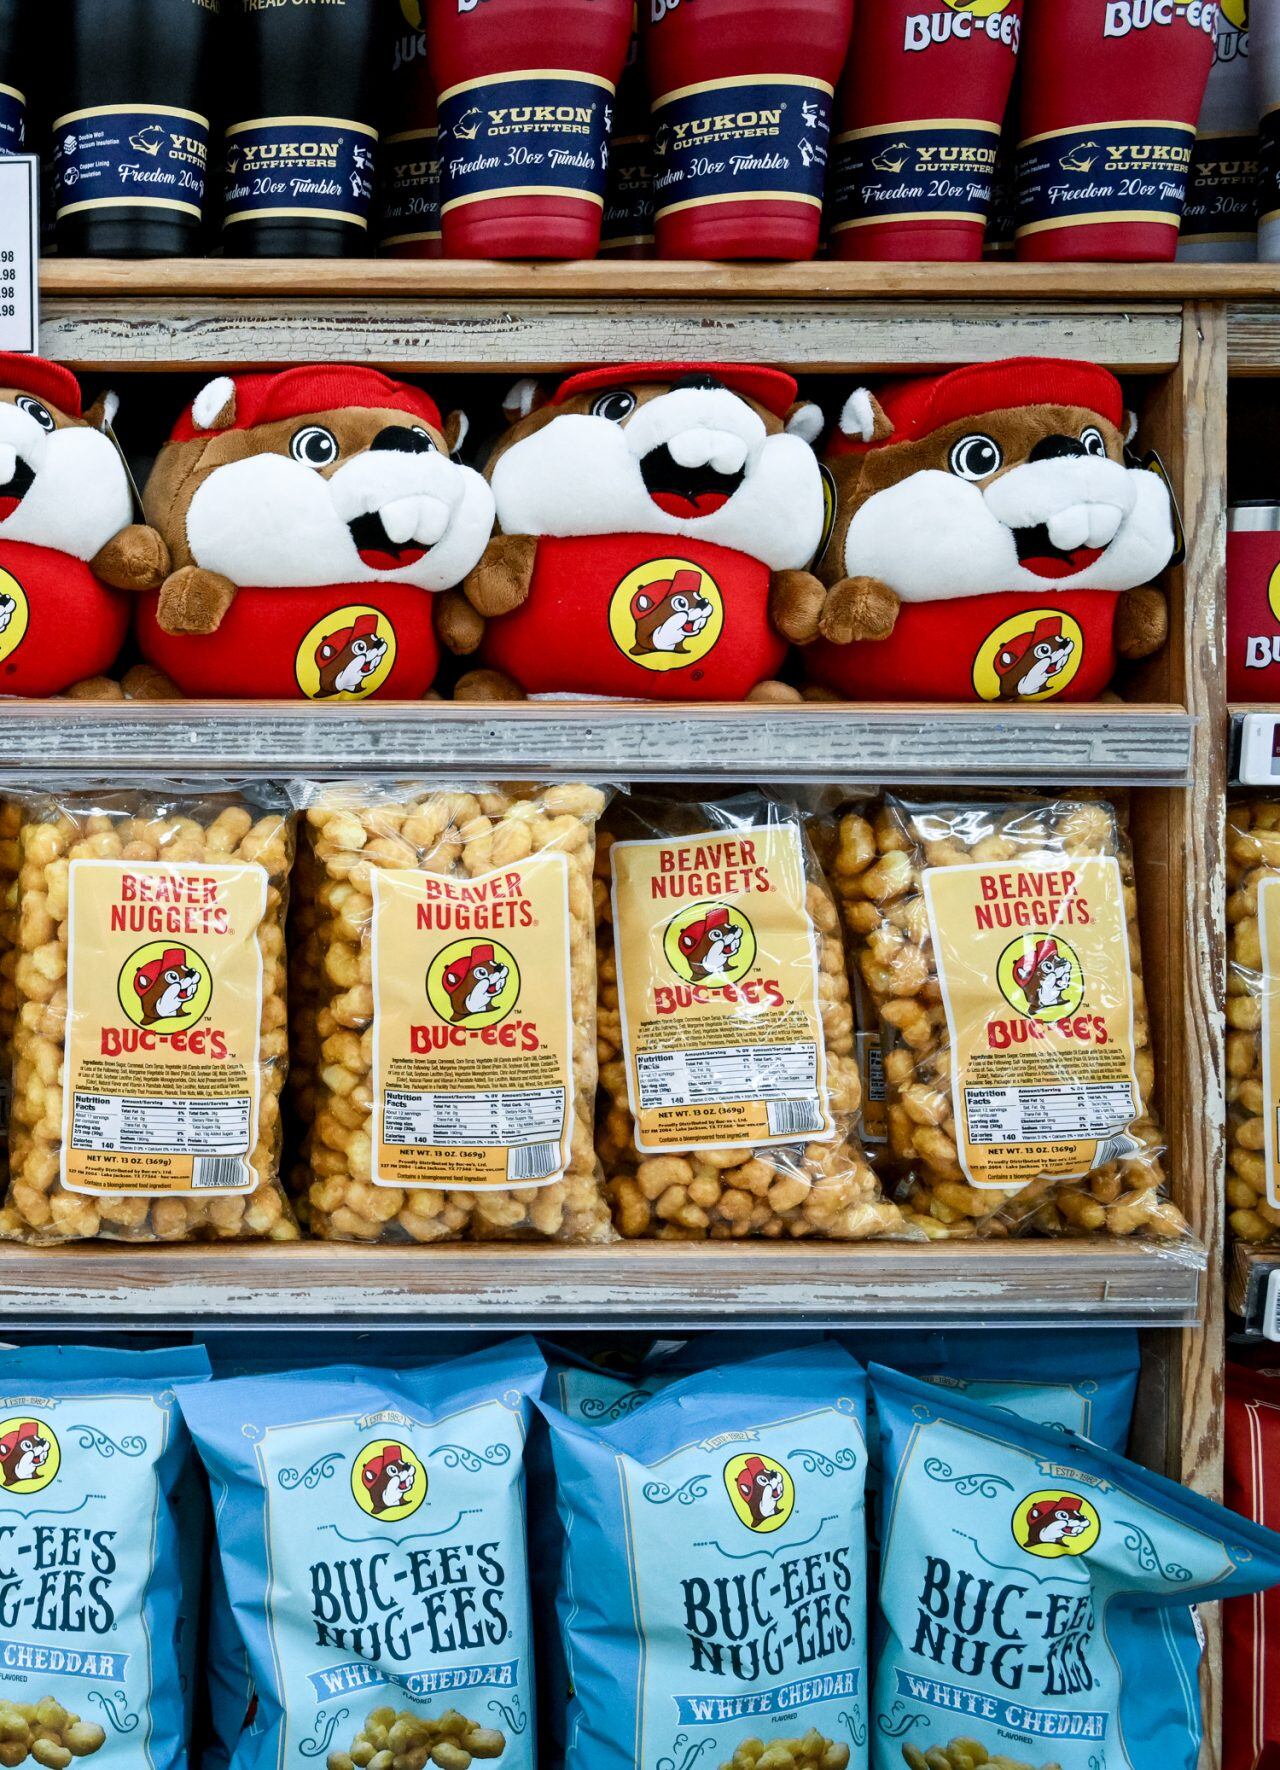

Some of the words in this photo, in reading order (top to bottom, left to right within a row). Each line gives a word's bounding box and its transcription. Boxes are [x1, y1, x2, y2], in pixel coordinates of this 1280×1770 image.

[488, 106, 593, 124] YUKON
[488, 123, 590, 136] OUTFITTERS
[673, 109, 782, 138] YUKON
[243, 143, 339, 160] YUKON
[674, 127, 779, 150] OUTFITTERS
[1106, 146, 1192, 162] YUKON
[243, 159, 336, 171] OUTFITTERS
[450, 156, 500, 179] Freedom
[504, 146, 544, 166] 30oz
[548, 149, 595, 169] Tumbler
[687, 157, 725, 179] 30oz
[729, 153, 790, 175] Tumbler
[916, 147, 996, 163] YUKON
[118, 164, 176, 183] Freedom
[253, 177, 286, 195] 20oz
[290, 179, 342, 196] Tumbler
[862, 183, 924, 203] Freedom
[928, 180, 964, 197] 20oz
[1048, 183, 1114, 204] Freedom
[1118, 178, 1156, 196] 20oz
[660, 840, 756, 873] BEAVER
[122, 874, 218, 905] BEAVER
[425, 871, 523, 905] BEAVER
[651, 866, 770, 899] NUGGETS
[980, 870, 1078, 901] BEAVER
[111, 904, 228, 935] NUGGETS
[416, 900, 533, 931] NUGGETS
[974, 899, 1090, 930] NUGGETS
[653, 979, 785, 1015] BUC-EE'S
[101, 1027, 228, 1060] BUC-EE'S
[410, 1020, 539, 1055] BUC-EE'S
[987, 1013, 1109, 1049] BUC-EE'S
[386, 1092, 422, 1102] Nutrition
[387, 1100, 407, 1108] Facts
[309, 1542, 505, 1624] BUC-EE'S
[680, 1547, 851, 1641] BUC-EE'S
[313, 1587, 508, 1662] NUG-EES
[688, 1594, 852, 1681] NUG-EES
[3, 1644, 115, 1677] CHEDDAR
[909, 1608, 1093, 1696] NUG-EES
[320, 1663, 400, 1693] WHITE
[407, 1665, 512, 1693] CHEDDAR
[688, 1694, 772, 1721] WHITE
[778, 1673, 854, 1707] CHEDDAR
[907, 1677, 997, 1717] WHITE
[772, 1713, 798, 1723] FLAVORED
[997, 1729, 1033, 1744] FLAVORED
